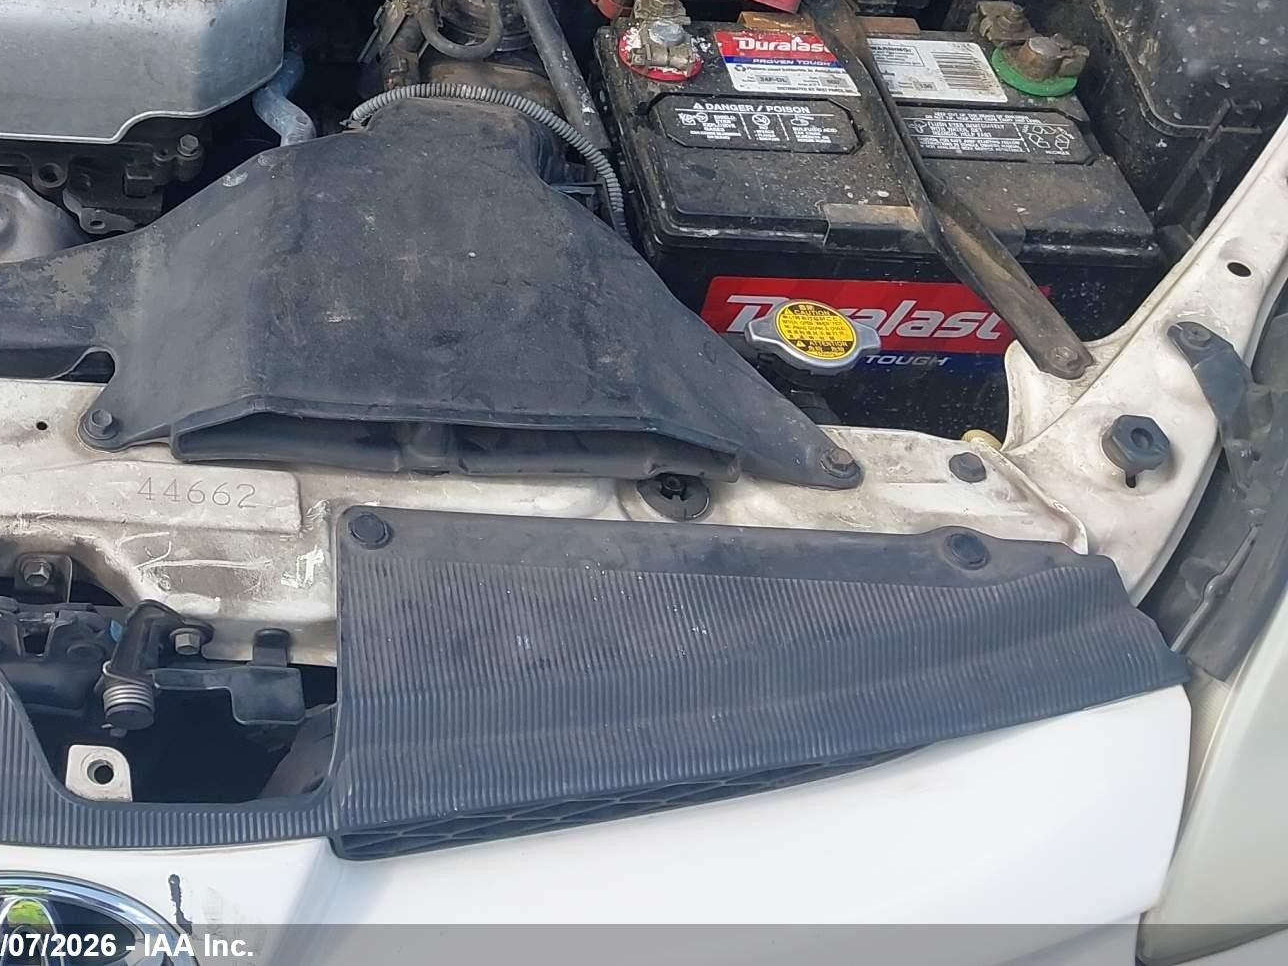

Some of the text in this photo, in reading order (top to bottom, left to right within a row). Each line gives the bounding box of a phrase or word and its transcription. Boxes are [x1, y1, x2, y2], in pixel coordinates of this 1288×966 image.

[732, 36, 831, 53] Duralas
[705, 103, 754, 112] DANGER
[866, 354, 950, 365] TOUGH
[137, 477, 257, 509] 44662
